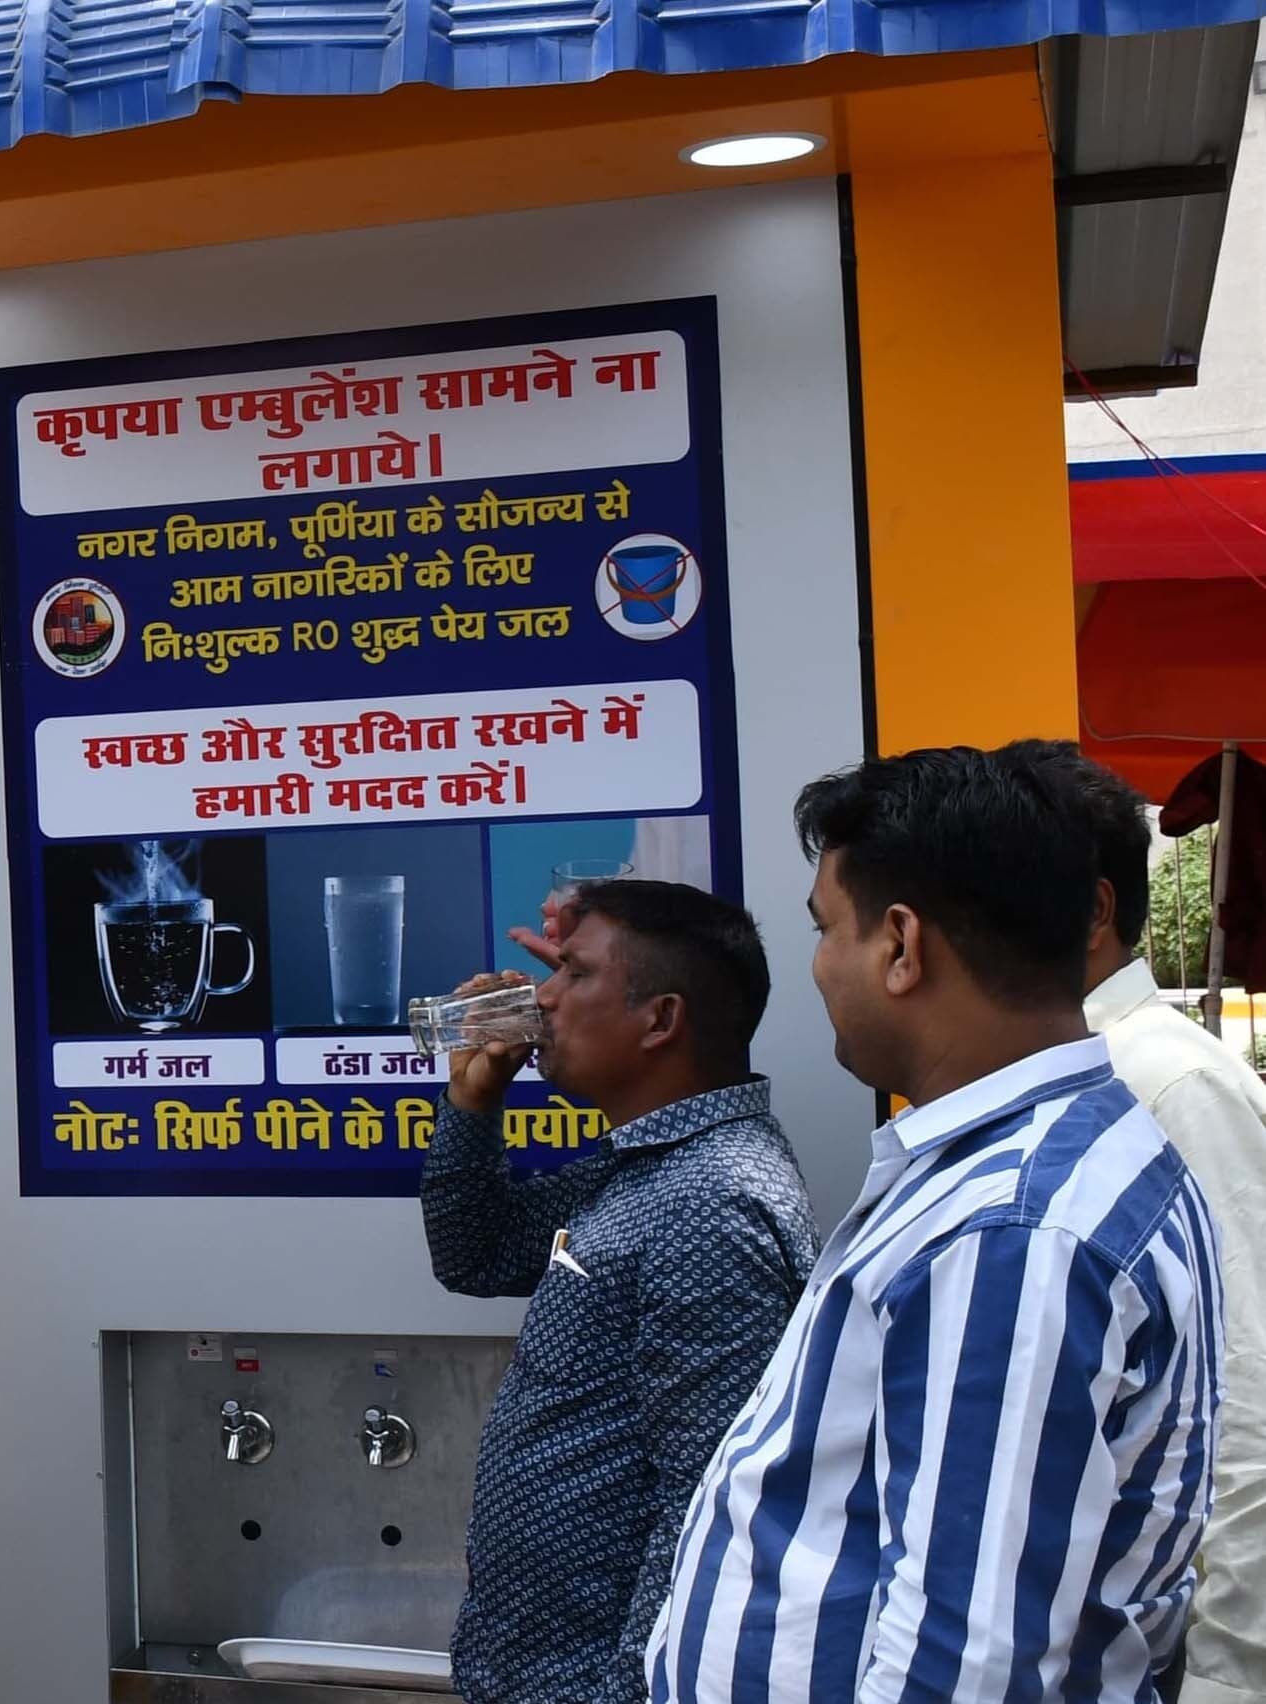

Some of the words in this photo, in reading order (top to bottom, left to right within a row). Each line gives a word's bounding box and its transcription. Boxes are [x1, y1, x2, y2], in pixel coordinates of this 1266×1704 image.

[34, 398, 181, 458] कृपया
[418, 350, 575, 410] सामने
[593, 351, 658, 392] ना
[76, 528, 157, 559] नगर
[163, 514, 277, 554] निगम,
[291, 501, 397, 559] पूर्णिया
[406, 496, 444, 534] के
[455, 490, 584, 532] सौजन्य
[595, 480, 630, 521] से
[170, 575, 242, 608] आम
[253, 552, 409, 599] नागरिकों
[414, 550, 452, 588] के
[462, 544, 533, 587] लिए
[293, 620, 339, 650] RO
[351, 616, 420, 664] शुद्ध
[430, 605, 486, 641] पेय
[497, 606, 569, 637] जल
[83, 732, 186, 769] स्वच्छ
[201, 719, 285, 762] और
[299, 711, 457, 769] सुरक्षित
[475, 701, 585, 747] रखने
[605, 695, 645, 739] में
[194, 773, 311, 819] हमारी
[328, 774, 426, 812] मदद
[438, 761, 526, 806] करें।
[101, 1048, 150, 1079] गर्म
[156, 1055, 213, 1078] जल
[320, 1044, 373, 1076] ठंडा
[380, 1052, 436, 1075] जल
[152, 1098, 242, 1150] सिर्फ
[253, 1098, 331, 1150] पीने
[342, 1097, 384, 1149] के
[395, 1098, 435, 1149] लि
